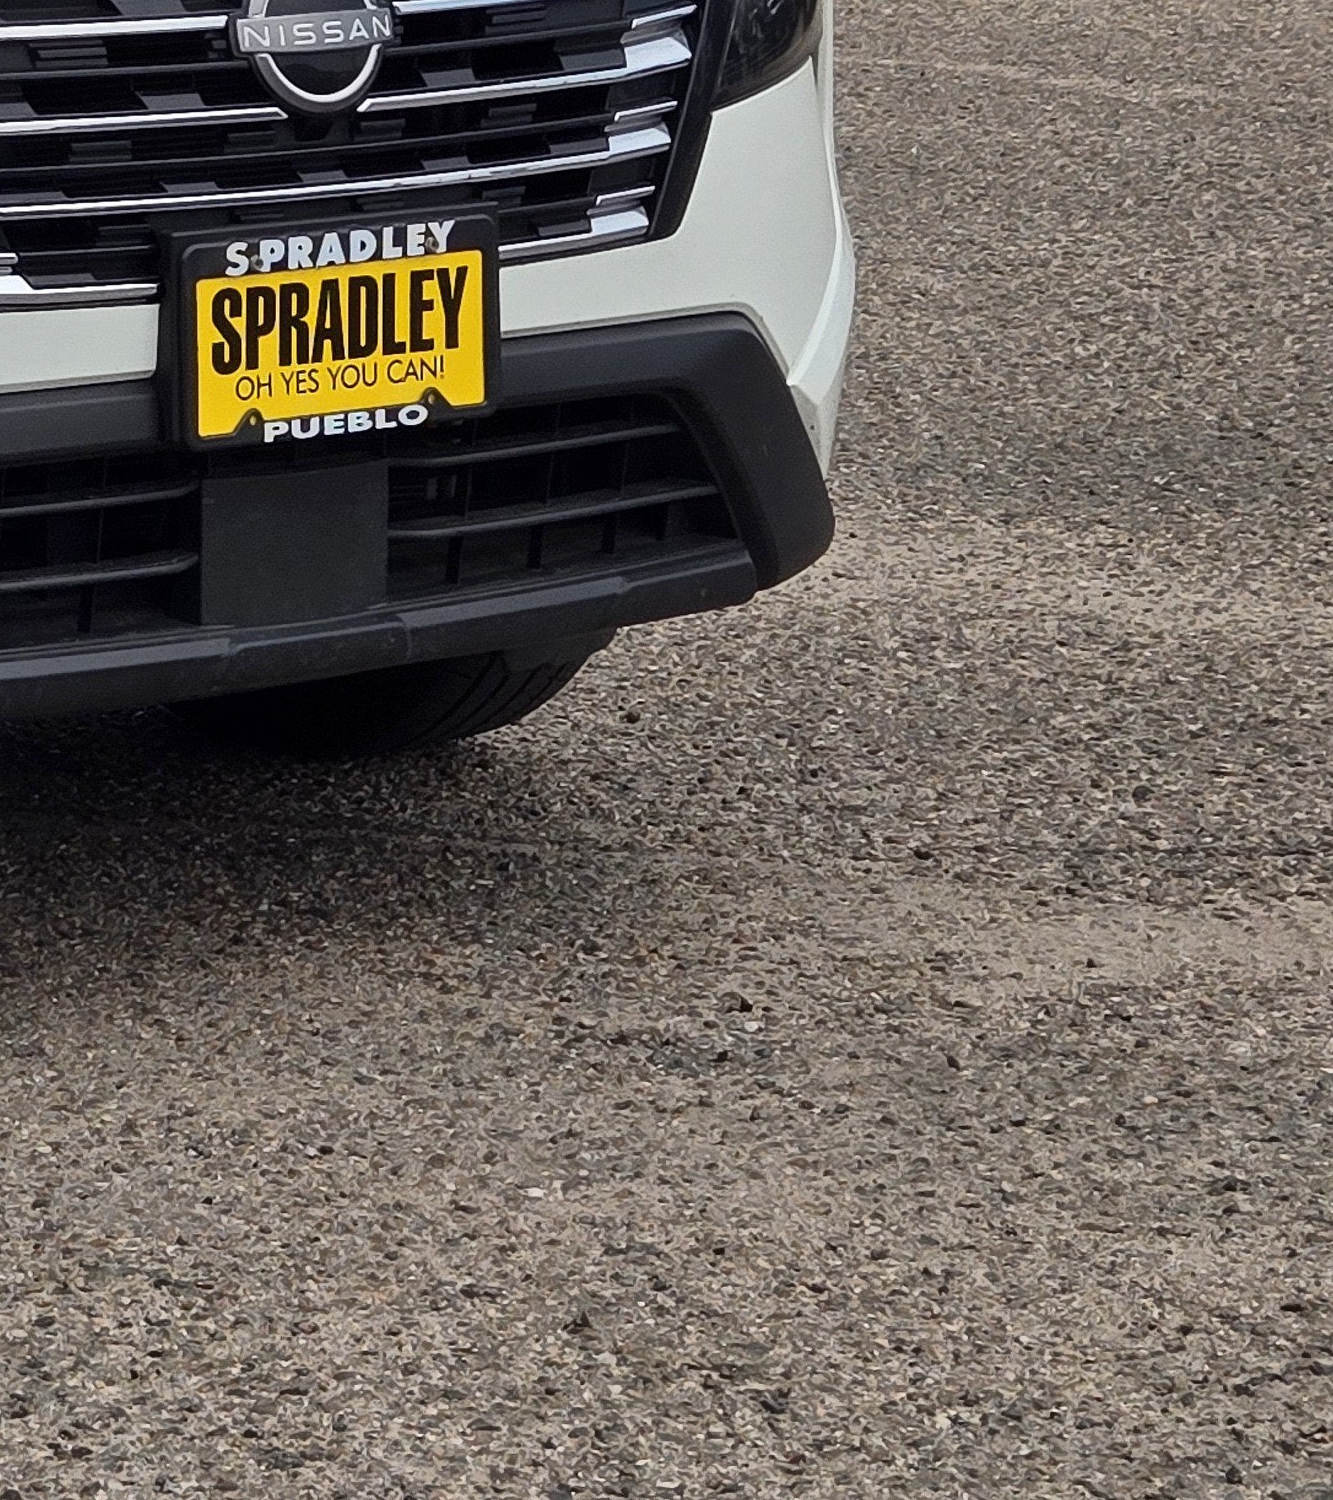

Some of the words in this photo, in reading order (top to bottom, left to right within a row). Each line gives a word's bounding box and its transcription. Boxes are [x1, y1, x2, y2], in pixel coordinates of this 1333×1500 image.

[243, 15, 391, 48] NISSAN
[225, 220, 456, 277] SPRADLEY
[211, 265, 469, 376] SPRADLEY
[235, 371, 273, 402] OH
[280, 368, 320, 397] YES
[327, 361, 379, 391] YOU
[387, 354, 446, 384] CAN!
[263, 404, 430, 444] PUEBLO
